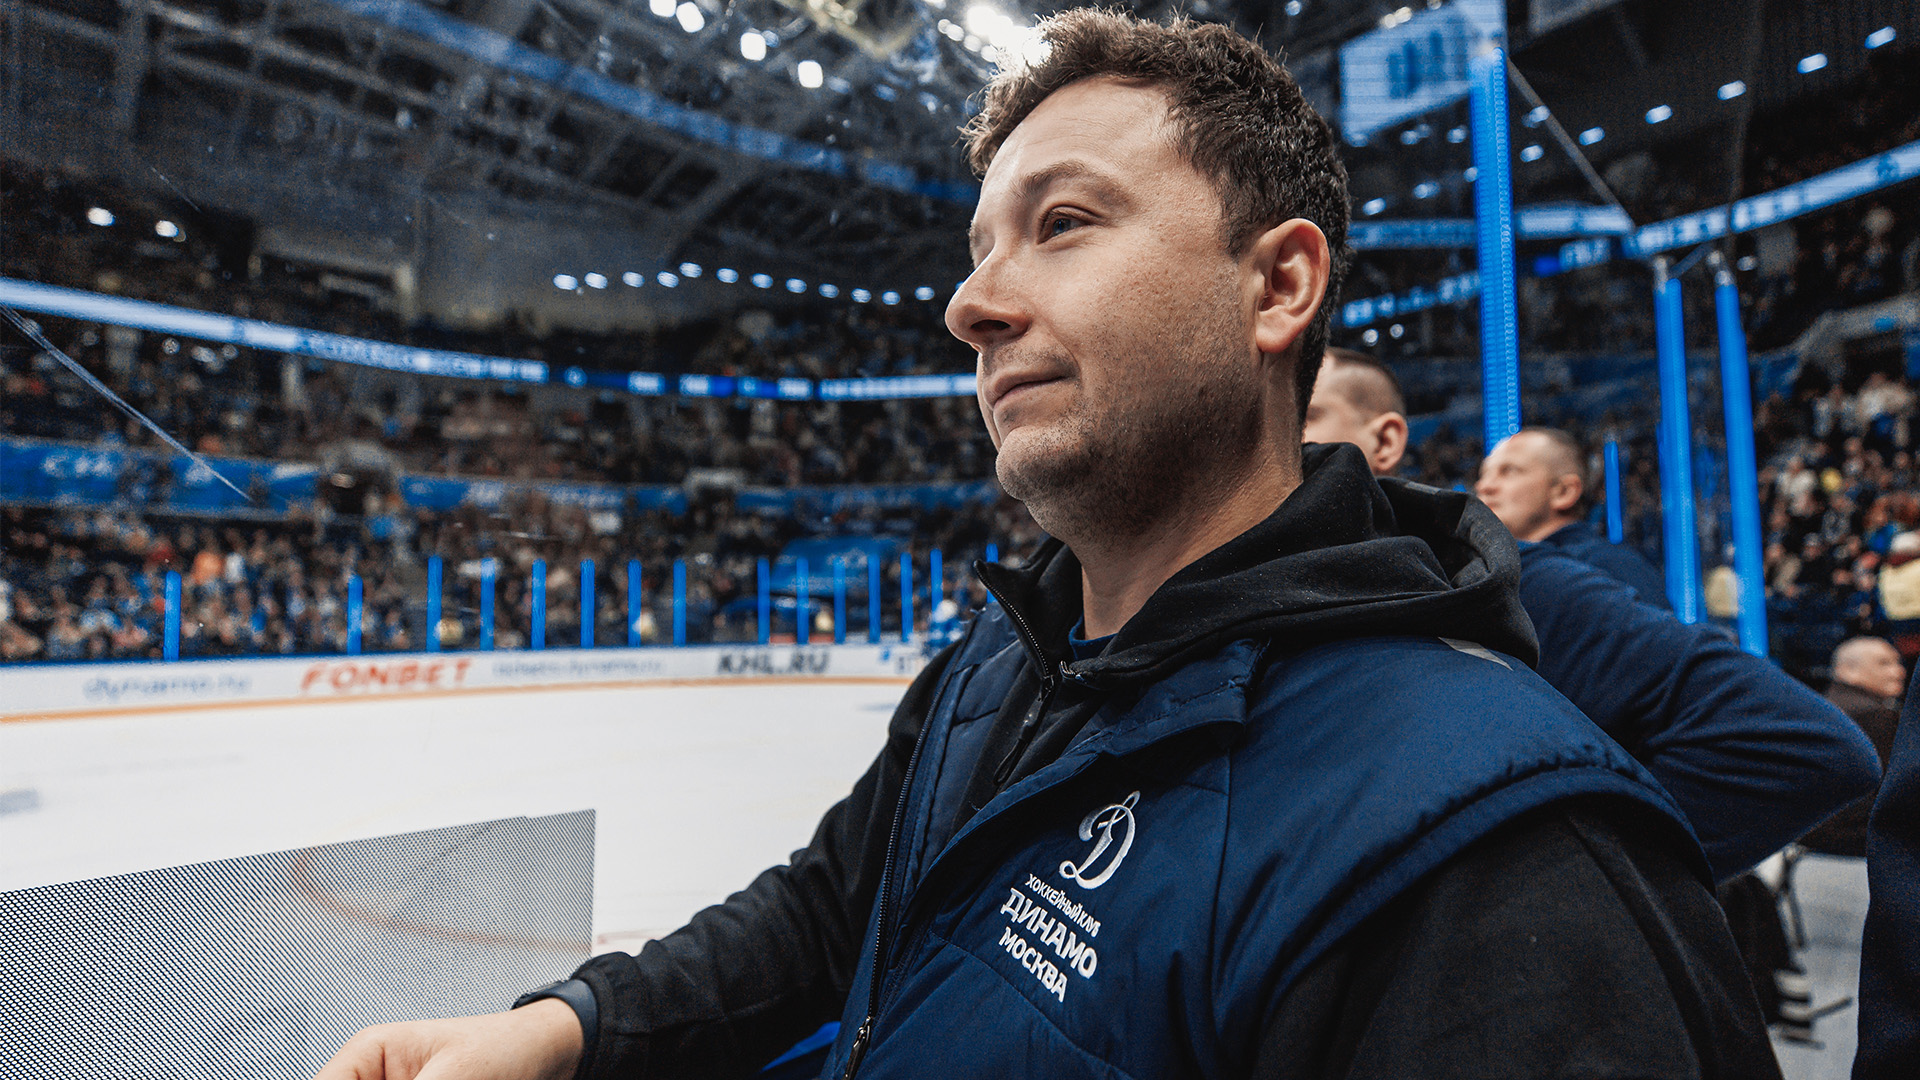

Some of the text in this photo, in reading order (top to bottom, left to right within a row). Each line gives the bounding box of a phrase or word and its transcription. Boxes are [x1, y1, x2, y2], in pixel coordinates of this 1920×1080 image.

[301, 657, 472, 691] FONBET
[716, 651, 830, 676] KHL.RU
[1025, 873, 1083, 922] ХОККЕЙНЫЙ
[1000, 887, 1098, 980] ДИНАМО
[999, 926, 1068, 1003] МОСКВА
